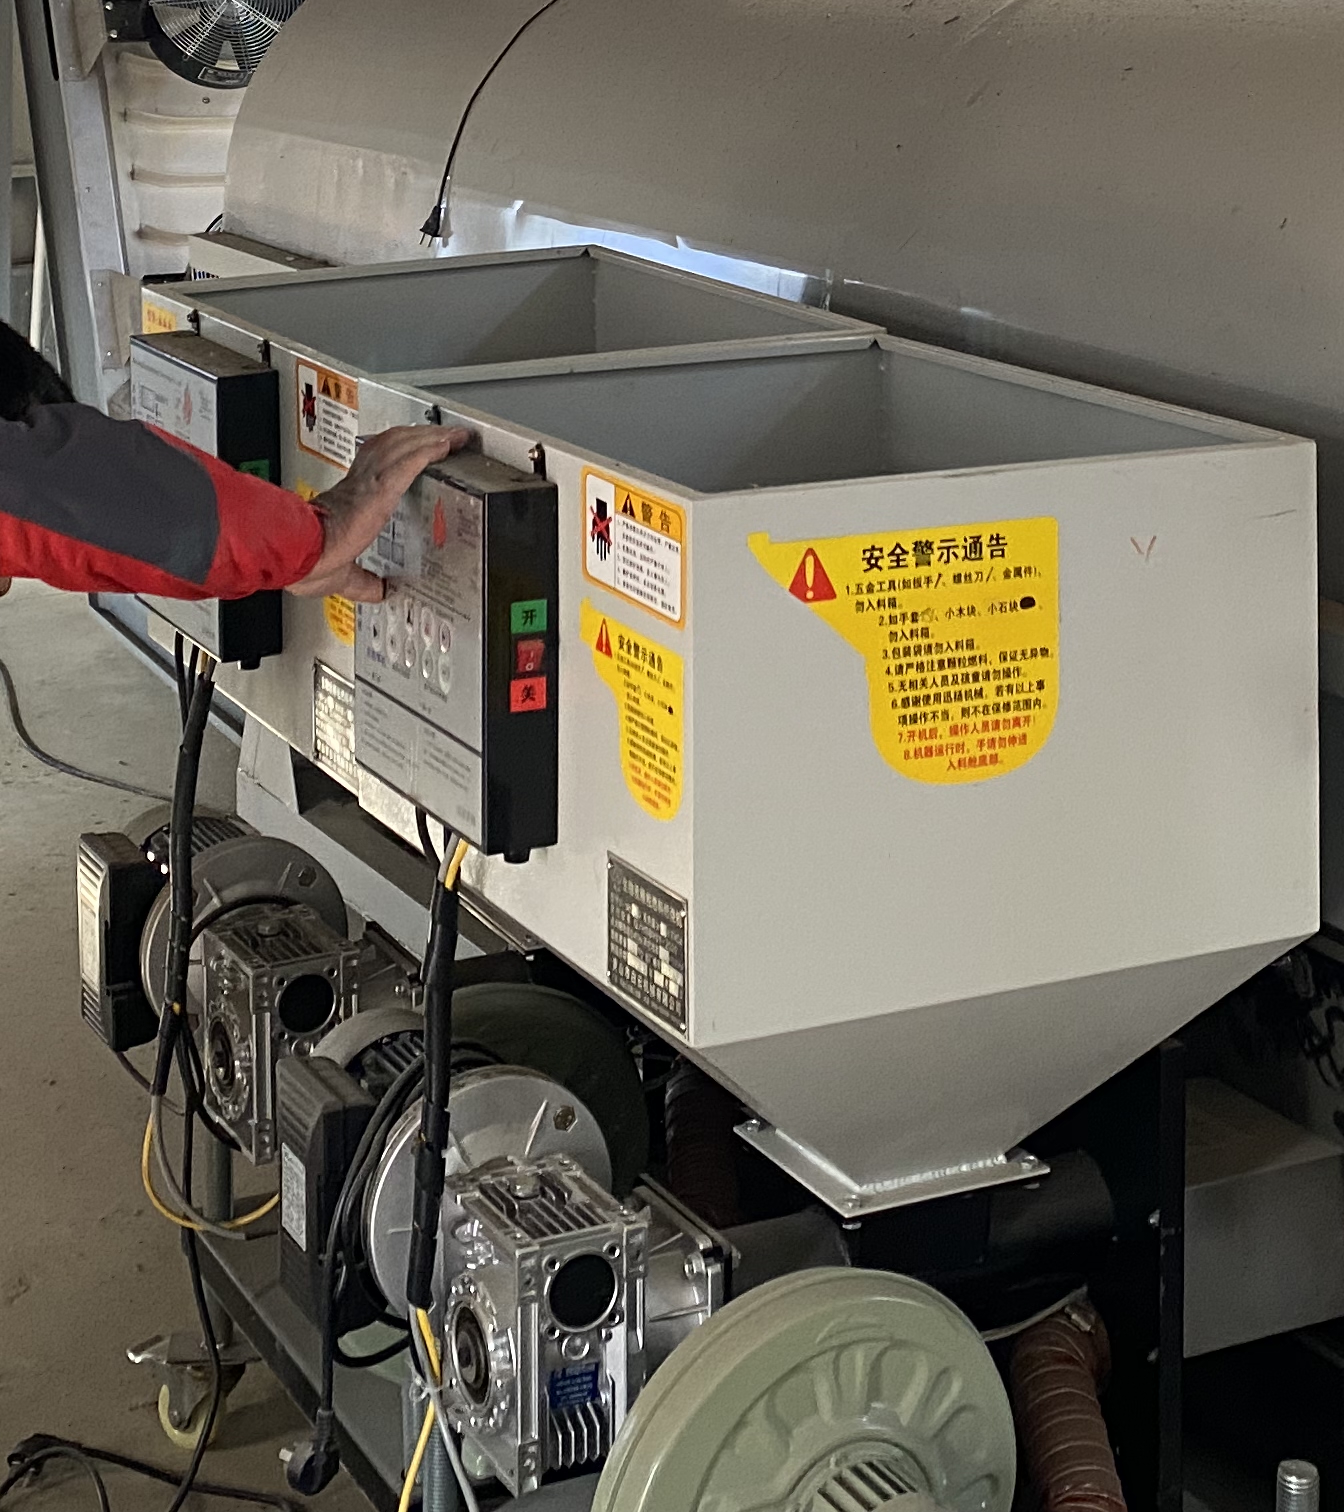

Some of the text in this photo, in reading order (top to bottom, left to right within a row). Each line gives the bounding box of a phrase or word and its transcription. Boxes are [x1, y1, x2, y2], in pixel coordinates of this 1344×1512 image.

[641, 501, 672, 534] 警告
[862, 533, 1008, 573] 安全警示通告
[522, 609, 536, 626] 开
[521, 684, 536, 704] 关
